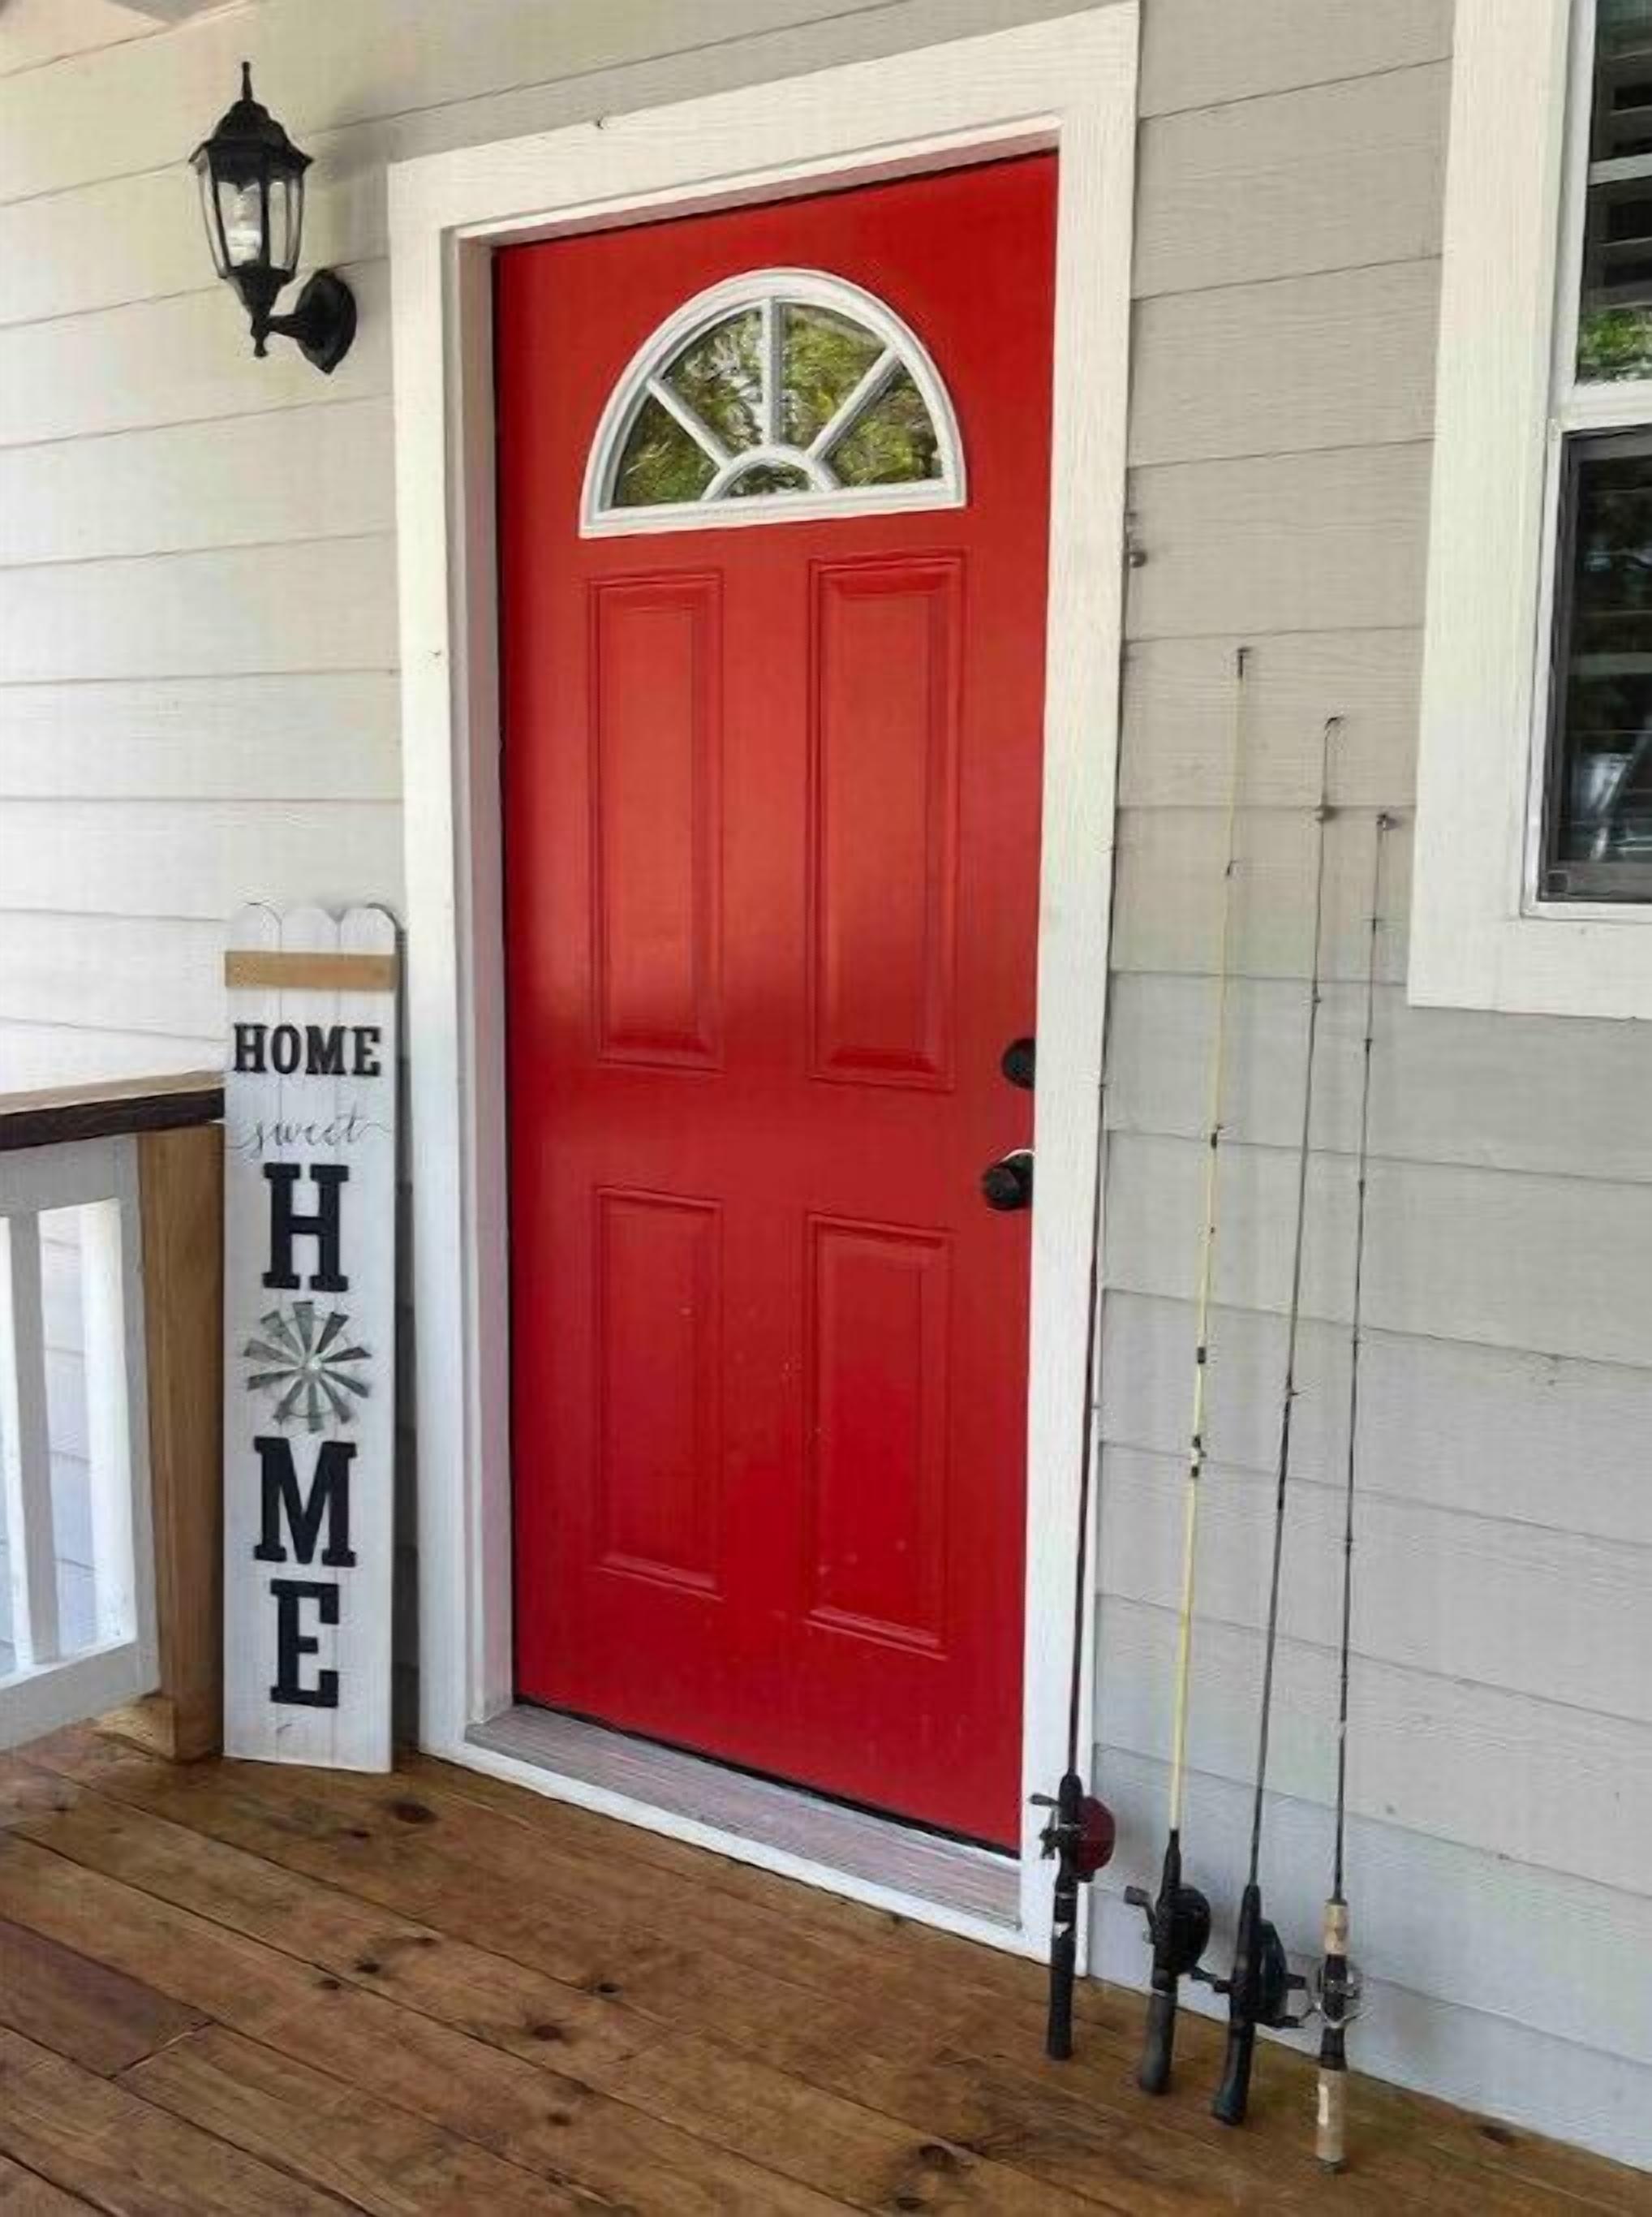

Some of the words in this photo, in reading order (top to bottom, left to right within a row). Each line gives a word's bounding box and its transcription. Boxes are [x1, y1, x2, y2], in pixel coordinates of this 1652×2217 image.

[233, 1023, 381, 1076] HOME
[226, 1100, 392, 1159] sweet
[249, 1162, 367, 1708] HME
